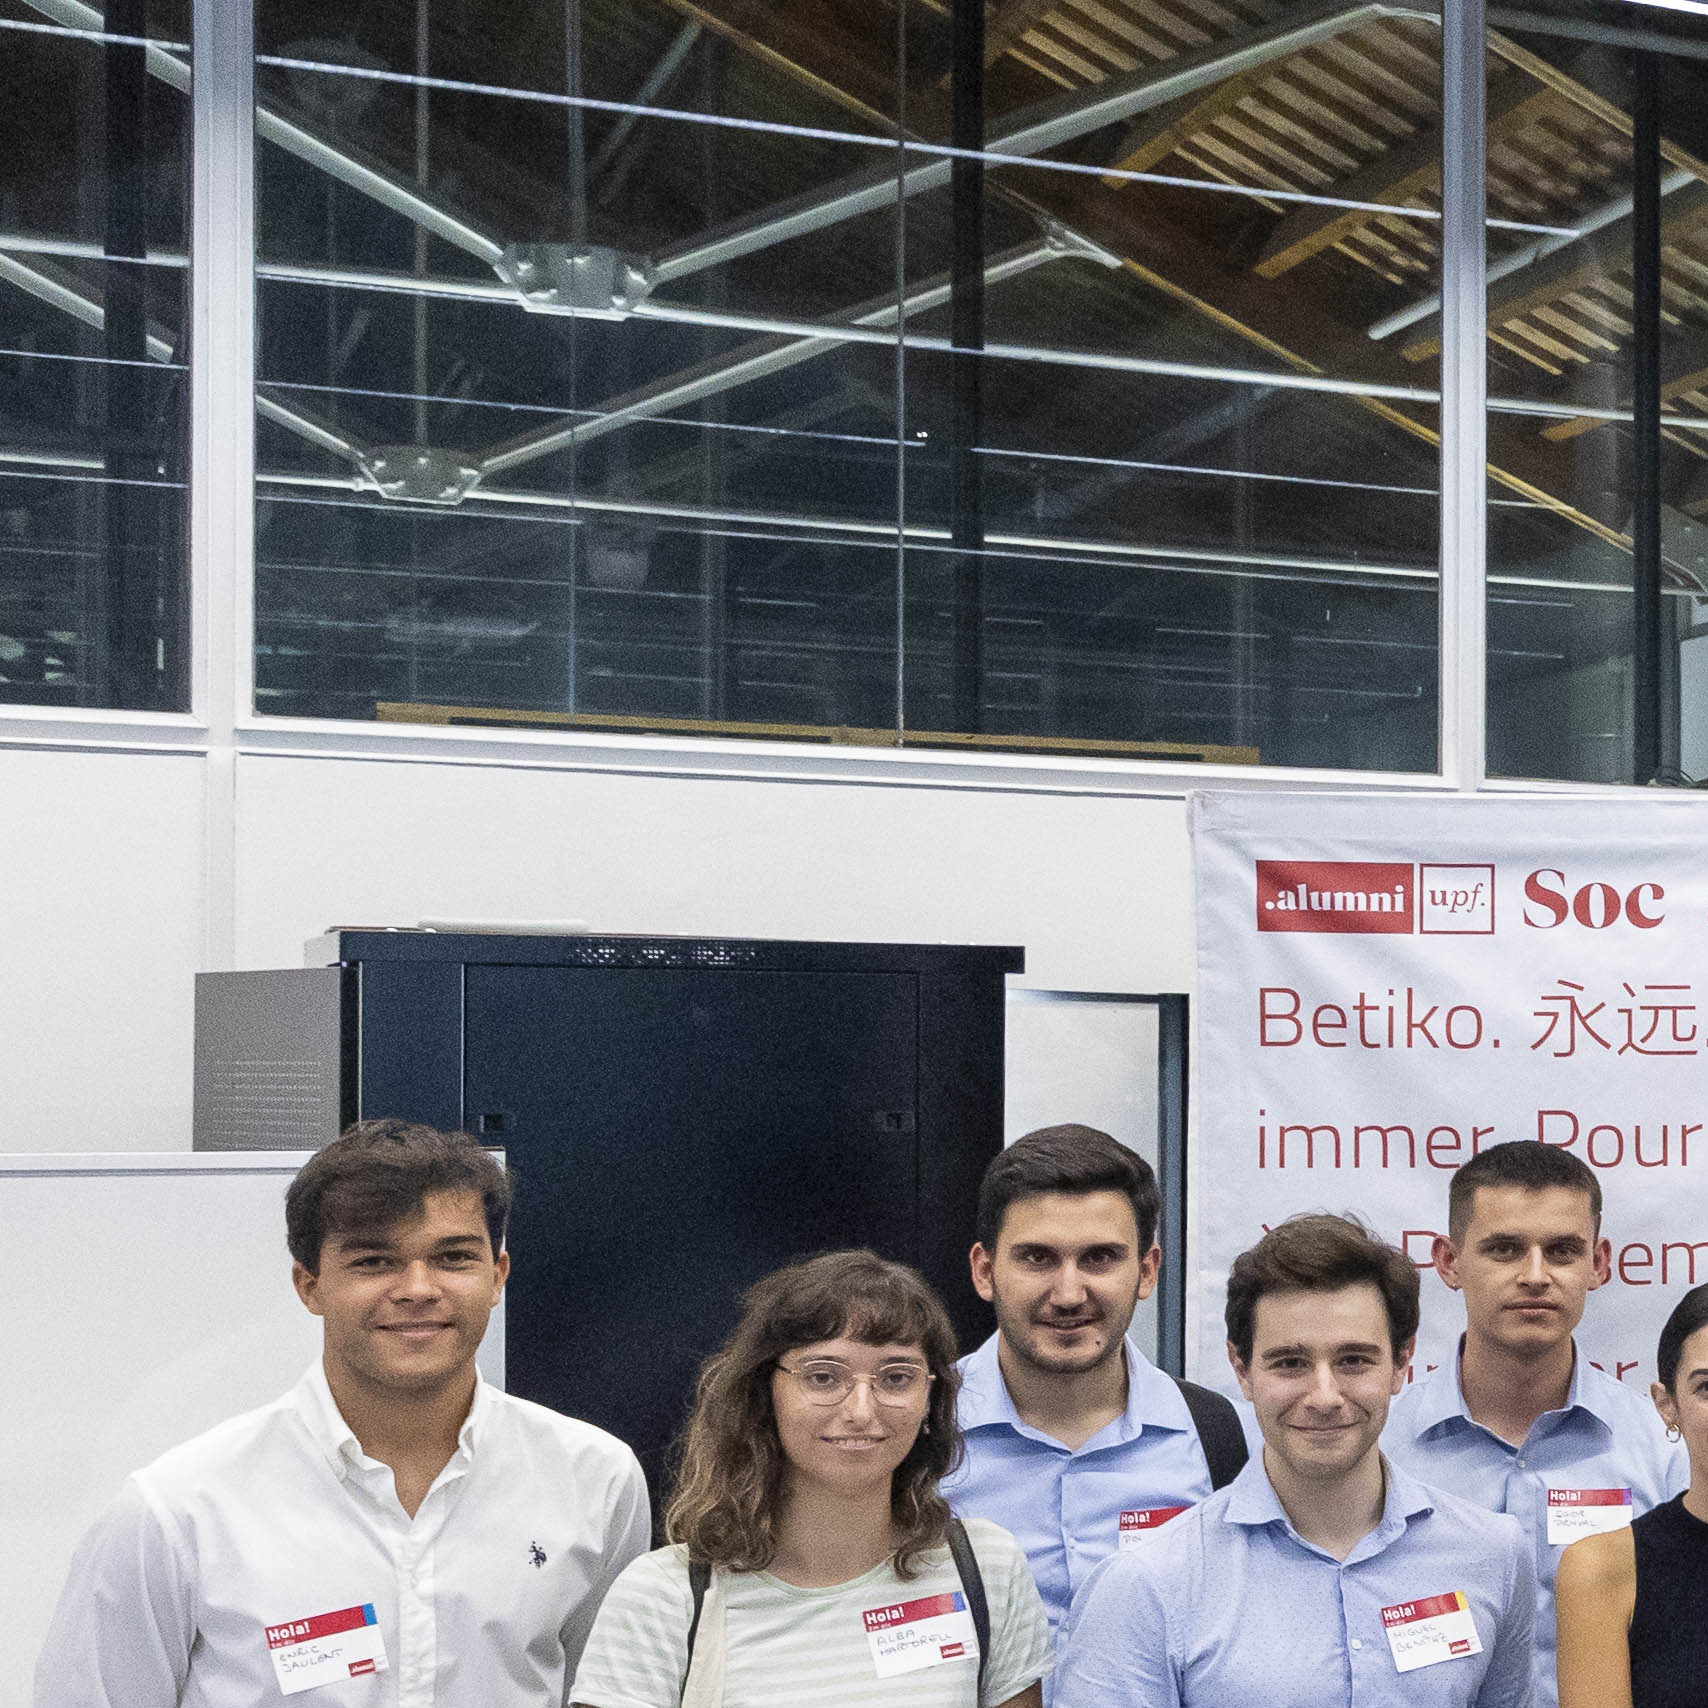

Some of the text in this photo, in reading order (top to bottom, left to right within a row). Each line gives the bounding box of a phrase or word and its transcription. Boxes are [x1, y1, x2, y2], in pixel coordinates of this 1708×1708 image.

[1264, 882, 1486, 914] .alumni upf.
[1523, 868, 1666, 930] Soc
[1259, 987, 1500, 1049] Betiko.
[1550, 1490, 1582, 1502] Hola!
[1120, 1511, 1151, 1524] Hola!
[865, 1605, 905, 1625] Hola!
[1382, 1604, 1416, 1622] Hola!
[267, 1620, 311, 1642] Hola!
